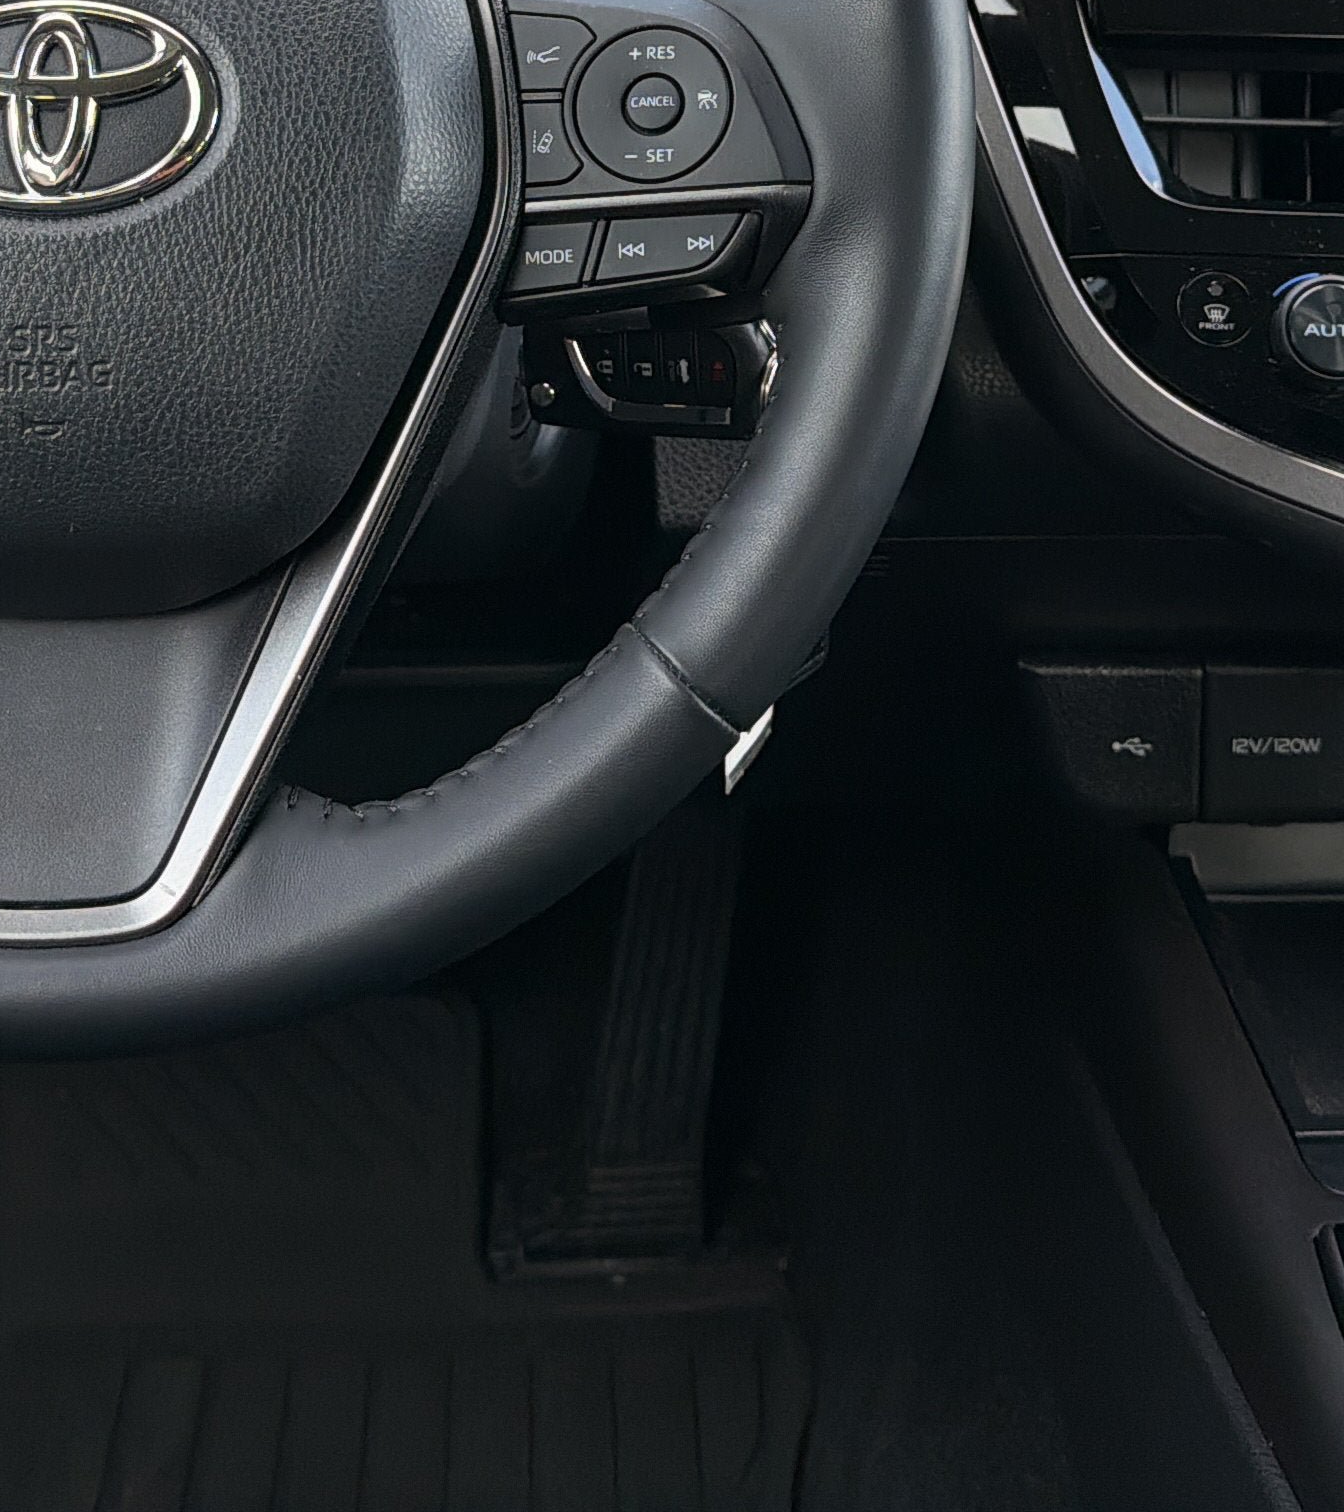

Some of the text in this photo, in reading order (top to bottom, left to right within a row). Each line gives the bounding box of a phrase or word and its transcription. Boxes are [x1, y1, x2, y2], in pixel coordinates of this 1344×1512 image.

[646, 45, 676, 61] RES
[630, 95, 676, 109] CANCEL
[646, 149, 675, 164] SET
[525, 249, 574, 266] MODE
[1198, 321, 1236, 332] FRONT
[7, 325, 81, 356] SRS
[1232, 737, 1321, 754] 12V/120W
